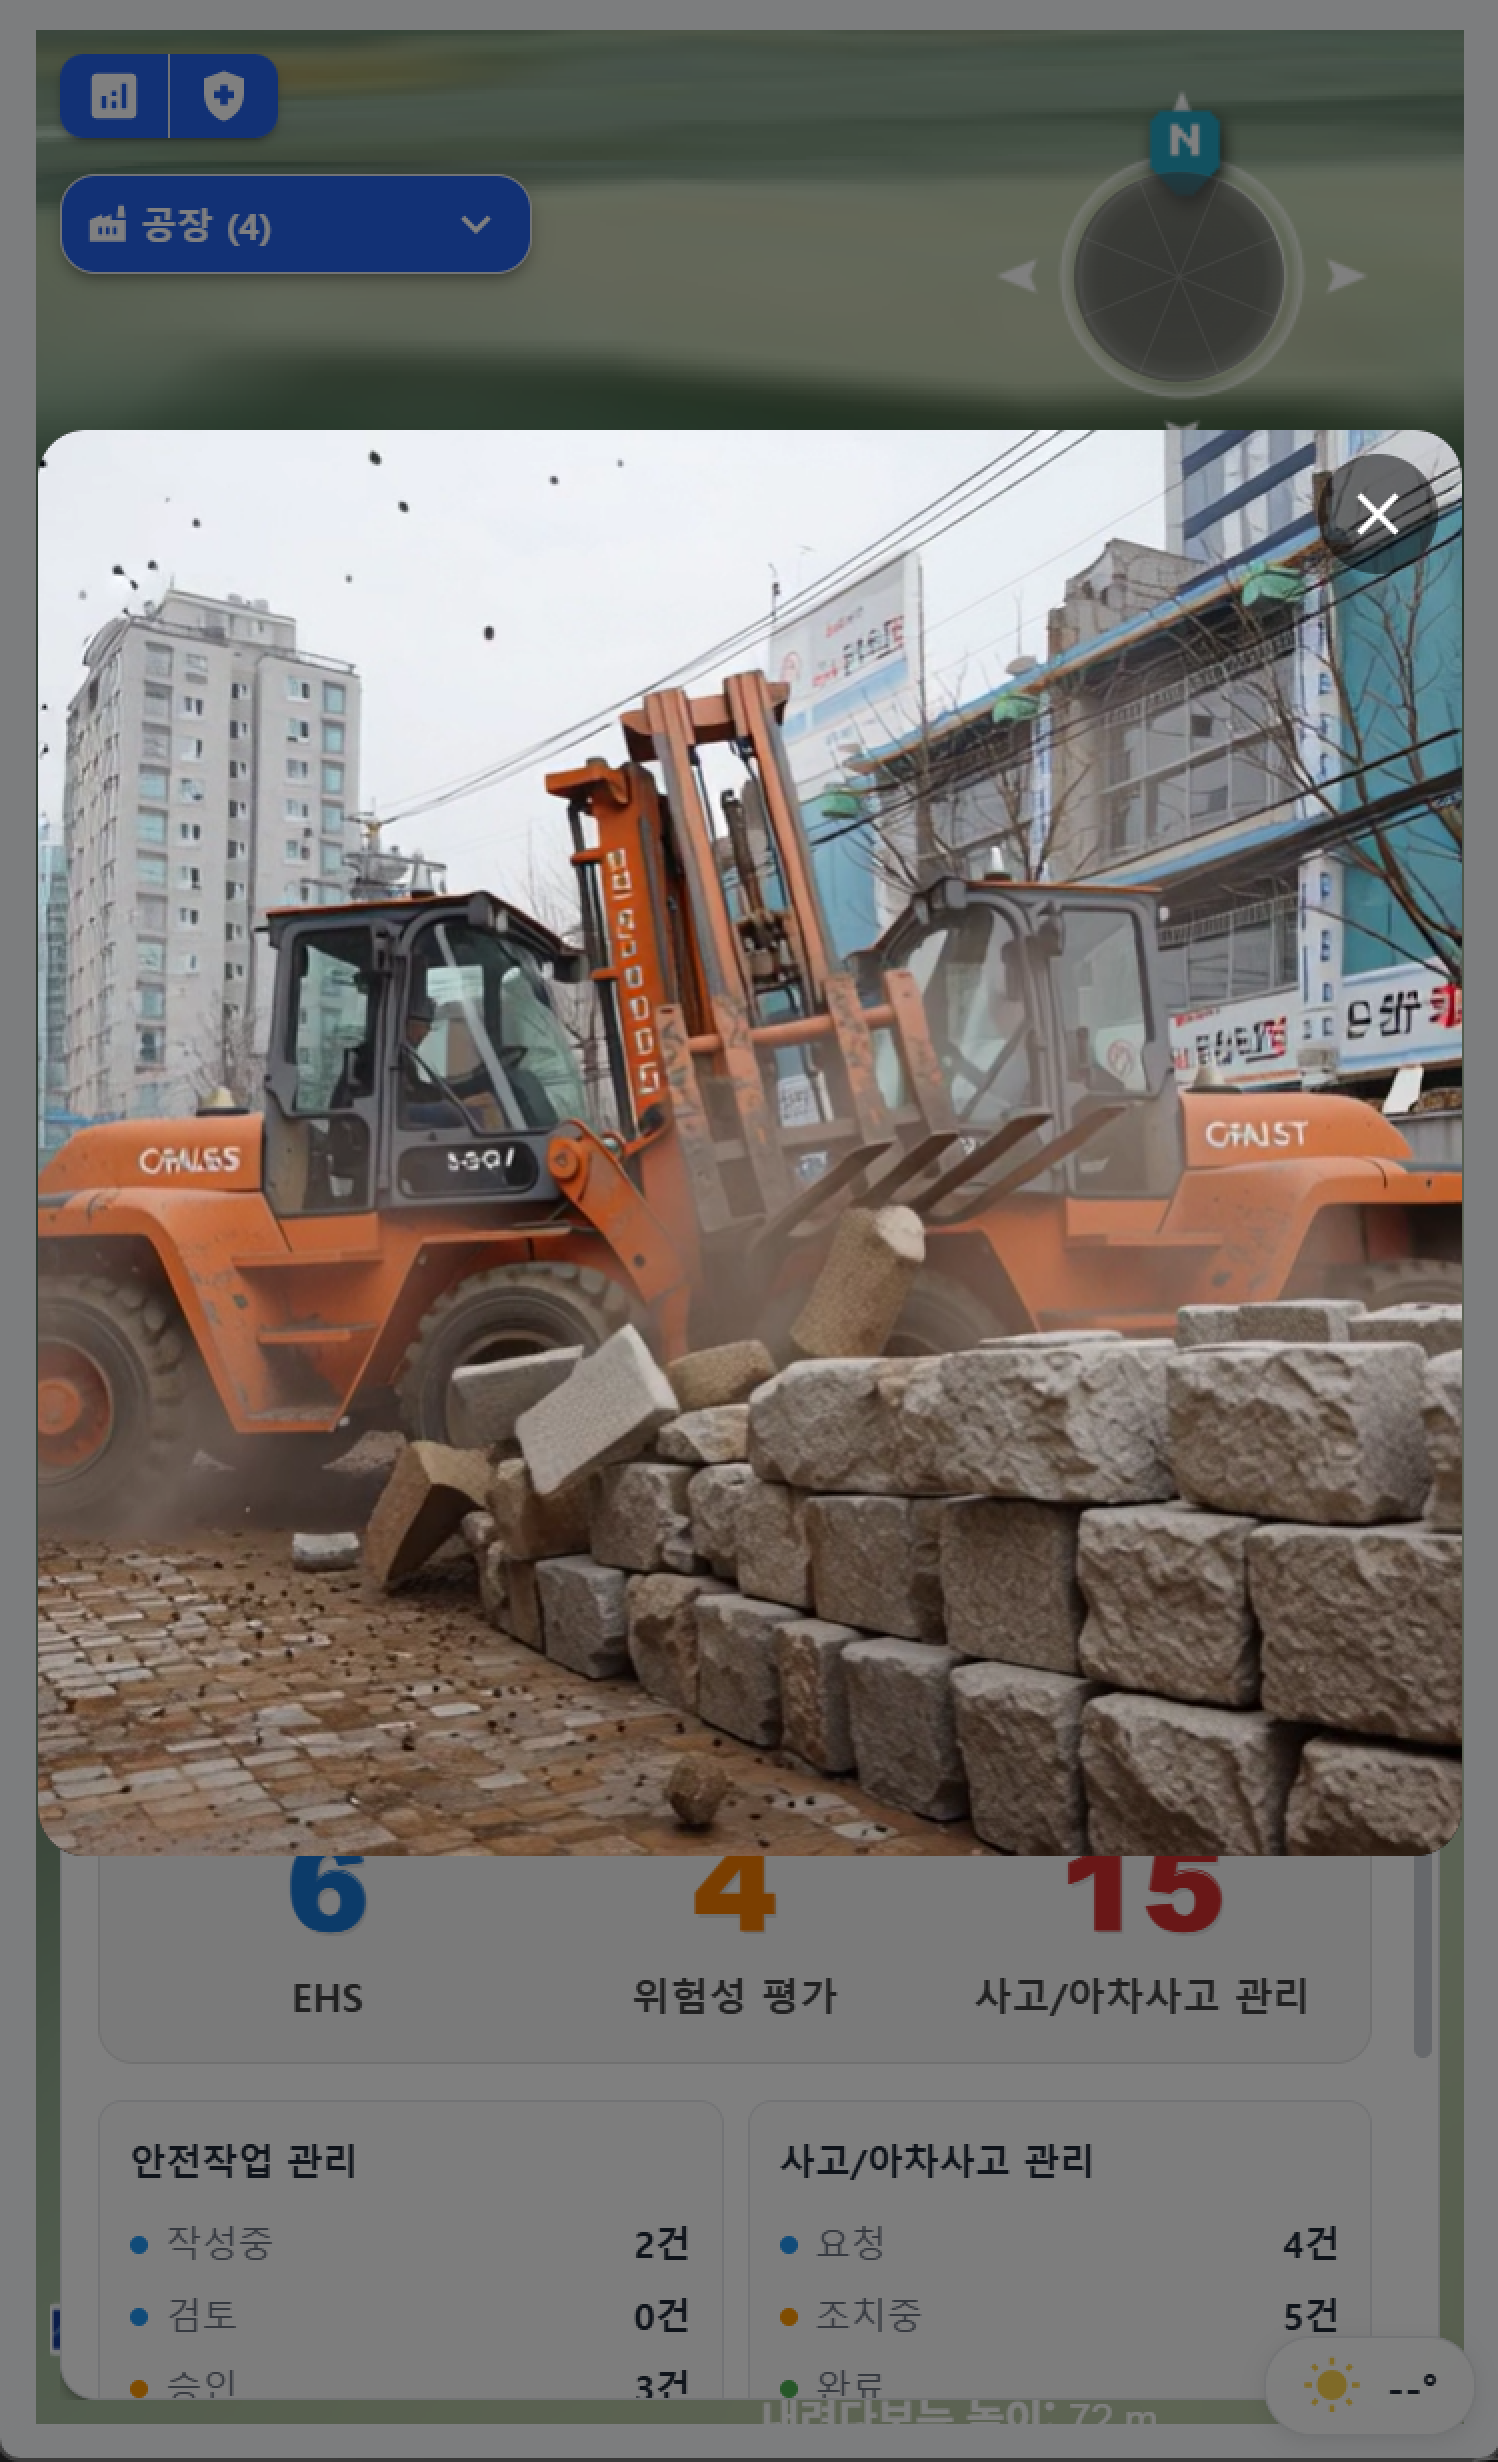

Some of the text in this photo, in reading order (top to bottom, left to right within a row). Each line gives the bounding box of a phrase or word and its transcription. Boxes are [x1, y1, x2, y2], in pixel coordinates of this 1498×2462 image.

[1169, 123, 1201, 157] N
[141, 207, 273, 247] 공장 (4)
[289, 1856, 367, 1933] 6
[693, 1856, 777, 1933] 4
[1067, 1856, 1223, 1933] 15
[293, 1983, 363, 2013] EHS
[633, 1977, 839, 2015] 위험성 평가
[975, 1977, 1307, 2017] 사고/아차사고 관리
[131, 2143, 355, 2179] 안전작업 관리
[779, 2143, 1091, 2181] 사고/아차사고 관리
[167, 2225, 273, 2261] 작성중
[635, 2225, 689, 2261] 2건
[815, 2225, 883, 2261] 요청
[1283, 2225, 1337, 2261] 4건
[168, 2297, 237, 2333] 검토
[634, 2297, 689, 2333] 0건
[815, 2297, 923, 2333] 조치중
[1284, 2297, 1337, 2333] 5건
